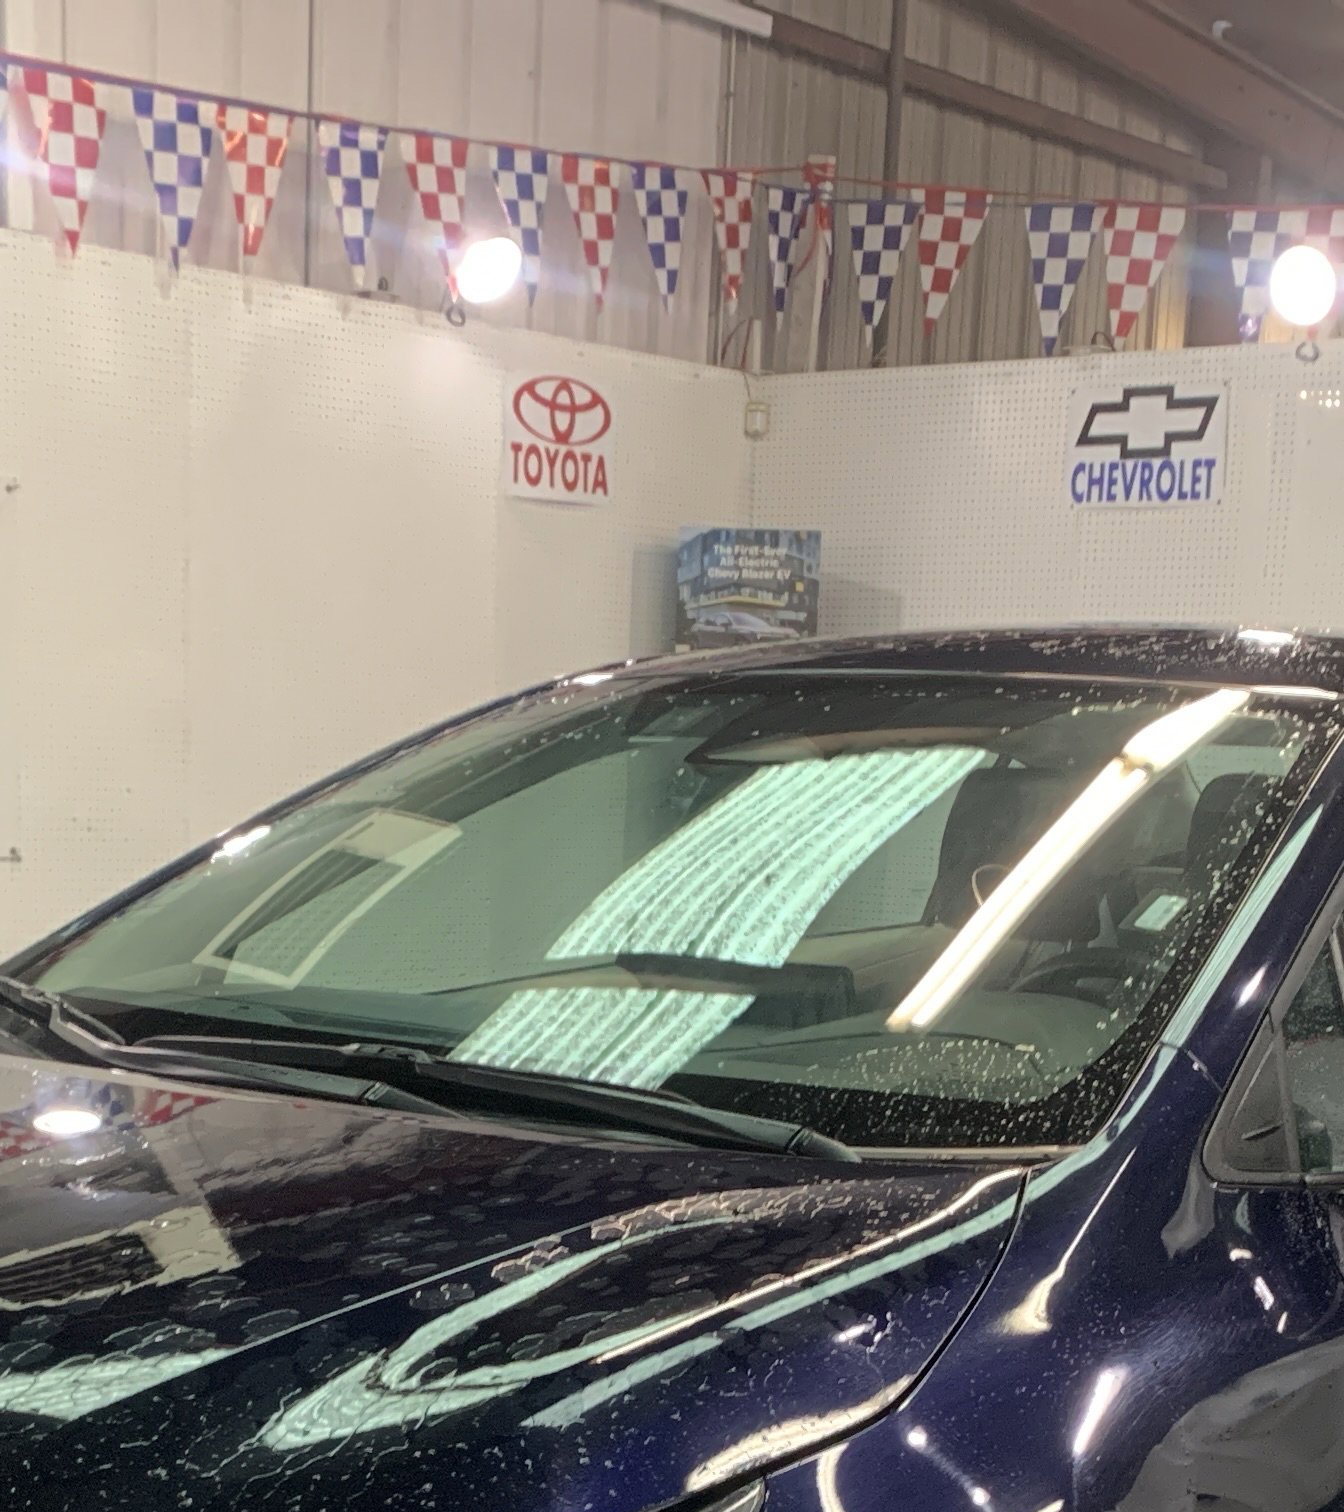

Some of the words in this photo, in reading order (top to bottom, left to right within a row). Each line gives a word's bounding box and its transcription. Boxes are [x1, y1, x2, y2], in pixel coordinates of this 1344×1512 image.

[510, 441, 610, 497] TOYOTA
[1070, 456, 1217, 505] CHEVROLET
[713, 544, 732, 555] The
[708, 567, 740, 581] Chevy
[742, 568, 775, 579] Blazer
[777, 569, 792, 580] EV
